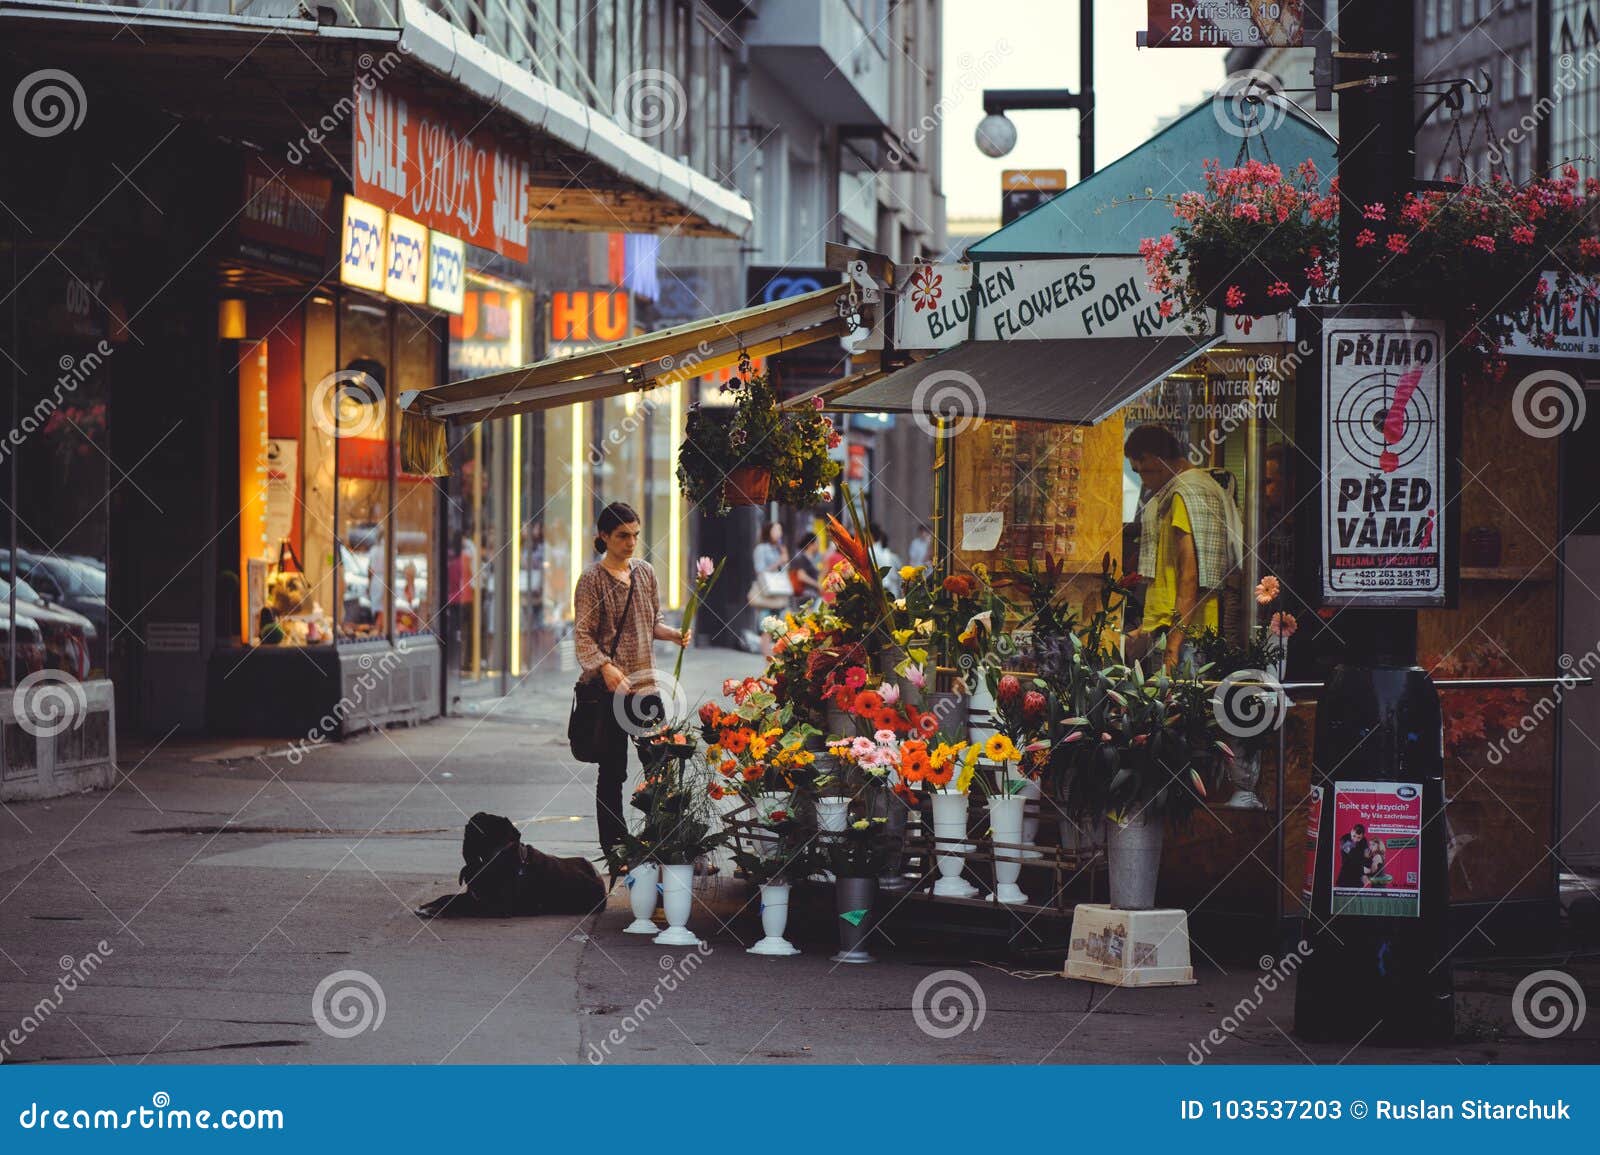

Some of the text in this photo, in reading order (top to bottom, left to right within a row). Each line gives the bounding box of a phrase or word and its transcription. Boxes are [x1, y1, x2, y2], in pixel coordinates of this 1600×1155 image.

[1170, 2, 1280, 23] Rytířská 10
[1170, 25, 1260, 45] 28 října 9
[357, 85, 408, 198] SALE
[412, 118, 486, 237] SHOES
[493, 151, 529, 247] SALE
[552, 290, 628, 341] HU
[993, 263, 1096, 341] FLOWERS
[1081, 276, 1142, 336] FIORI
[1335, 333, 1433, 366] PŘÍMO
[1337, 473, 1432, 512] PŘED
